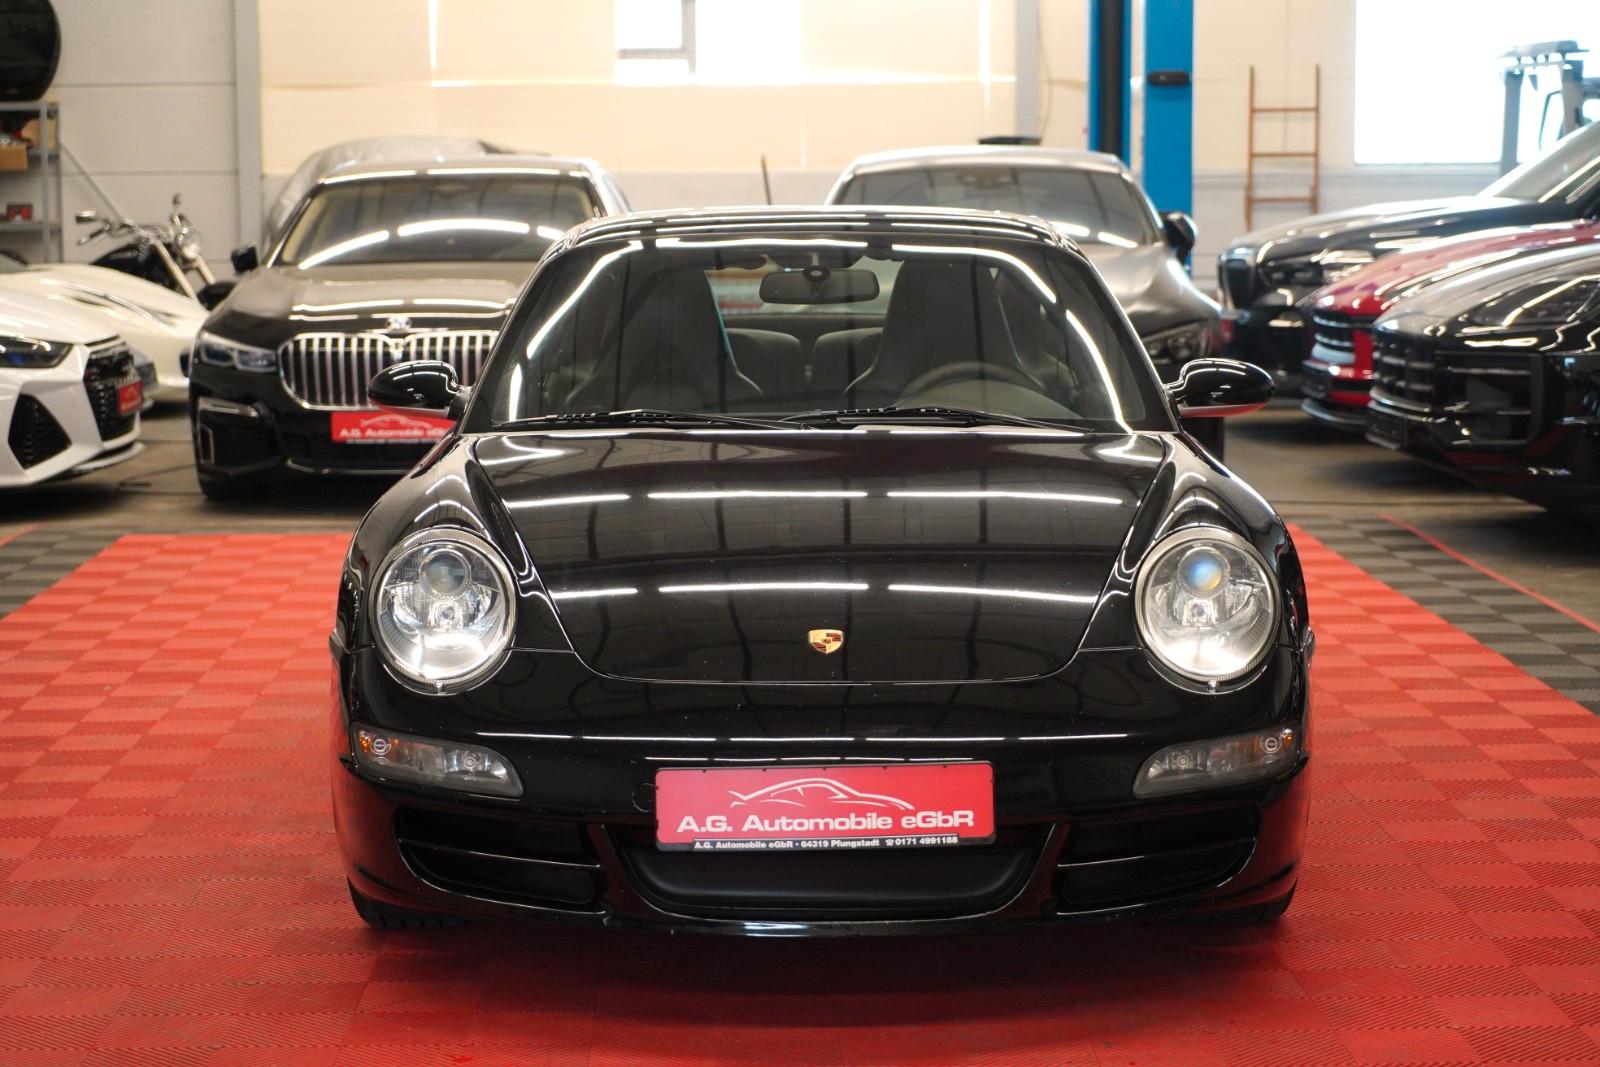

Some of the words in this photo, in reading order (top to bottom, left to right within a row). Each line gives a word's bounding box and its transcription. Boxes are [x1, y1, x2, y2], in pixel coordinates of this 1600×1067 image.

[677, 815, 733, 833] A.G.
[742, 813, 893, 832] Automobile
[901, 809, 975, 829] eGbR
[694, 841, 713, 849] A.G.
[715, 840, 767, 849] Automobile
[769, 840, 793, 848] eGbR
[800, 840, 829, 848] 64319
[830, 838, 880, 848] Pfungstadt
